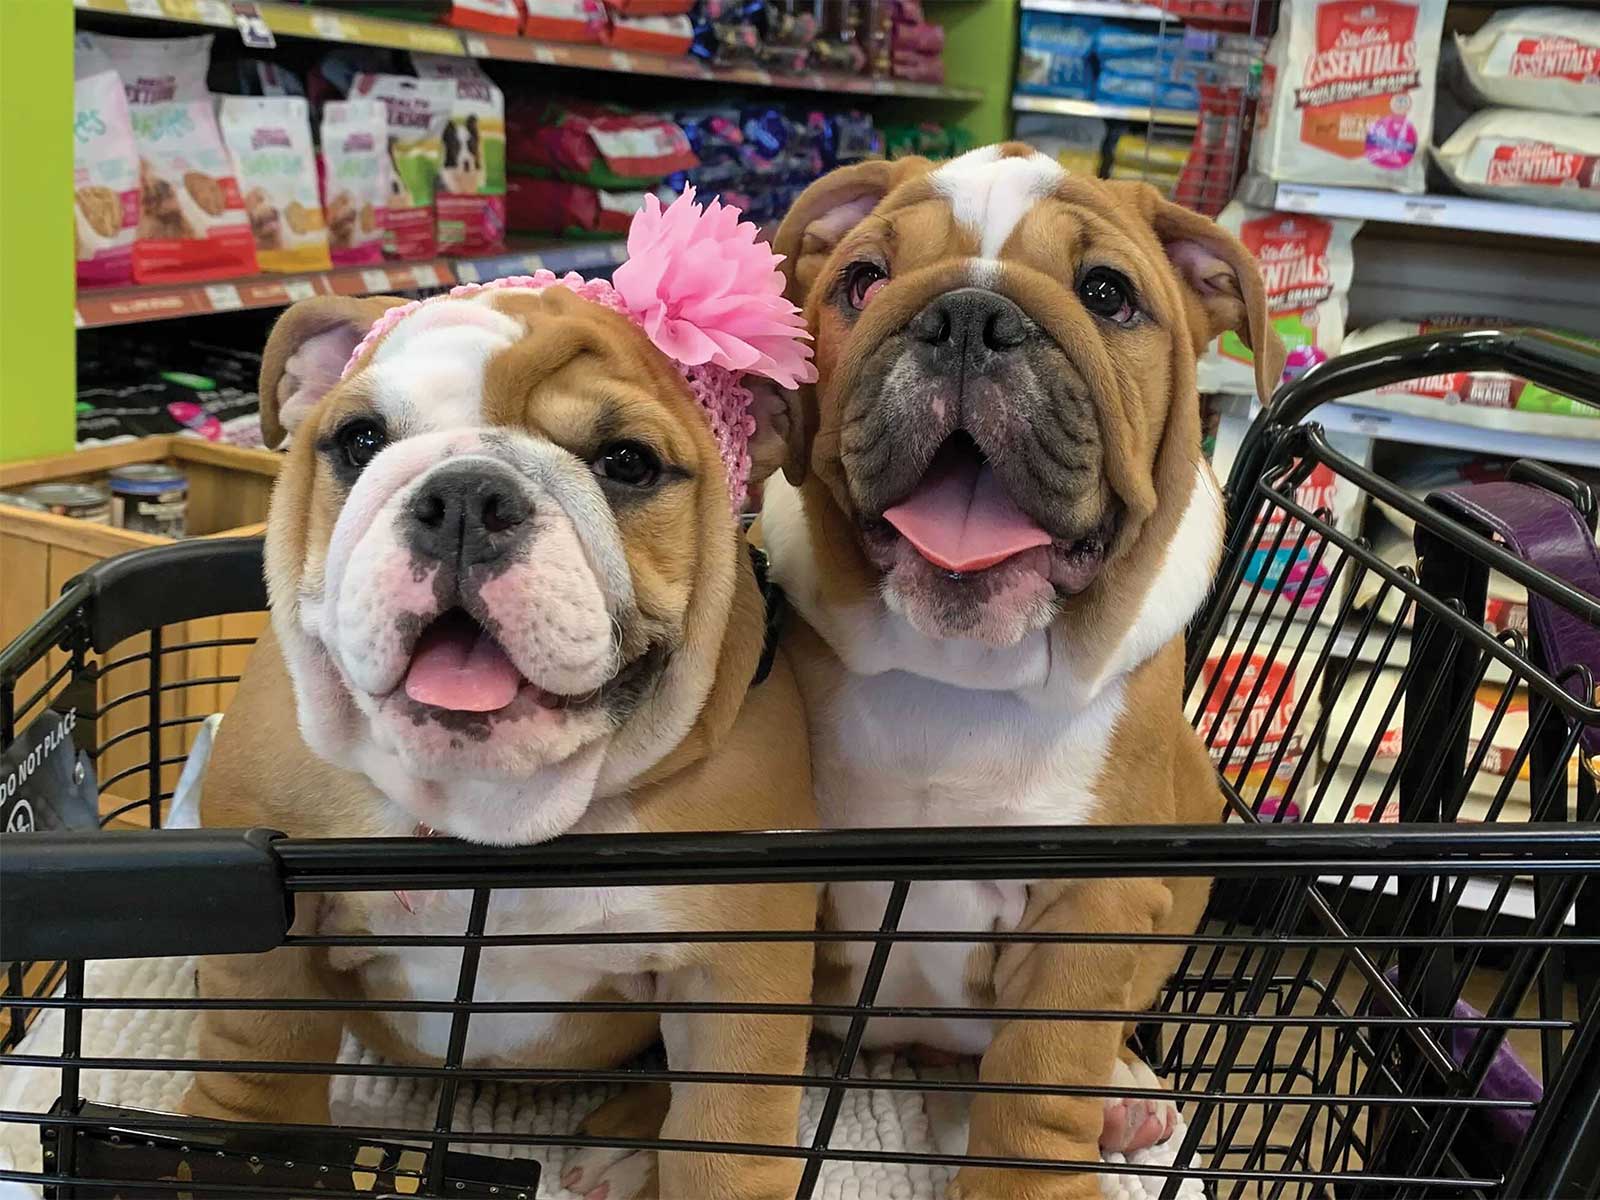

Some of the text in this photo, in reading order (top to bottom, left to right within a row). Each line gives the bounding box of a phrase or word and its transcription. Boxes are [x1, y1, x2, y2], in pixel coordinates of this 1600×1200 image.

[1303, 40, 1417, 88] ESSENTIALS
[1509, 46, 1597, 80] ESSENTIALS
[1487, 153, 1574, 185] ESSENTIALS
[0, 706, 76, 807] DO NOT PLACE
